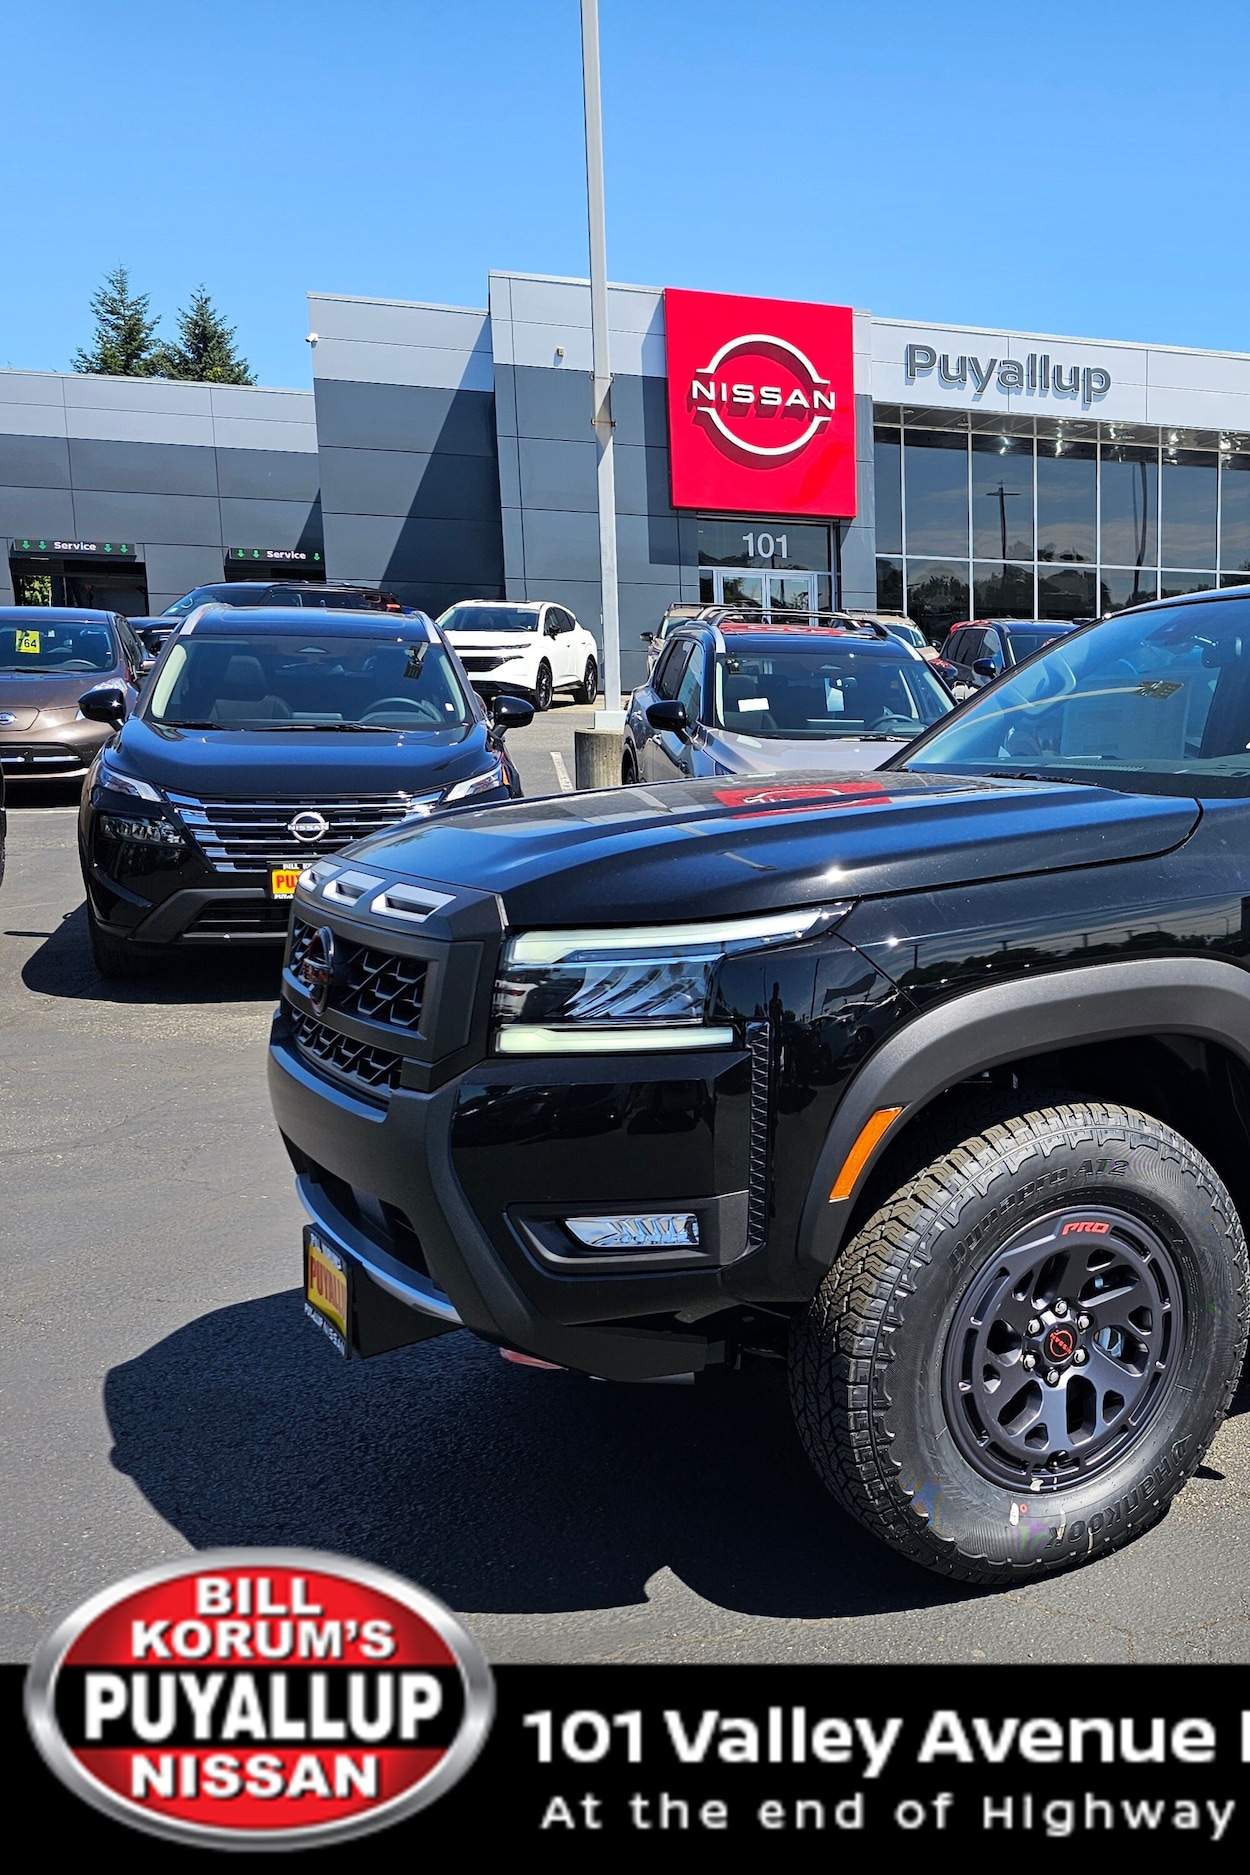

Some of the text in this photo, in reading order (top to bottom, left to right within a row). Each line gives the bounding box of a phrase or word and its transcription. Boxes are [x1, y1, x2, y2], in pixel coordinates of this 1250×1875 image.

[905, 343, 1112, 404] Puyallup
[691, 379, 836, 411] NISSAN
[53, 540, 97, 552] Service
[742, 532, 788, 559] 101
[266, 549, 307, 560] Service
[287, 822, 330, 832] NISSAN
[1061, 1221, 1111, 1236] PRO
